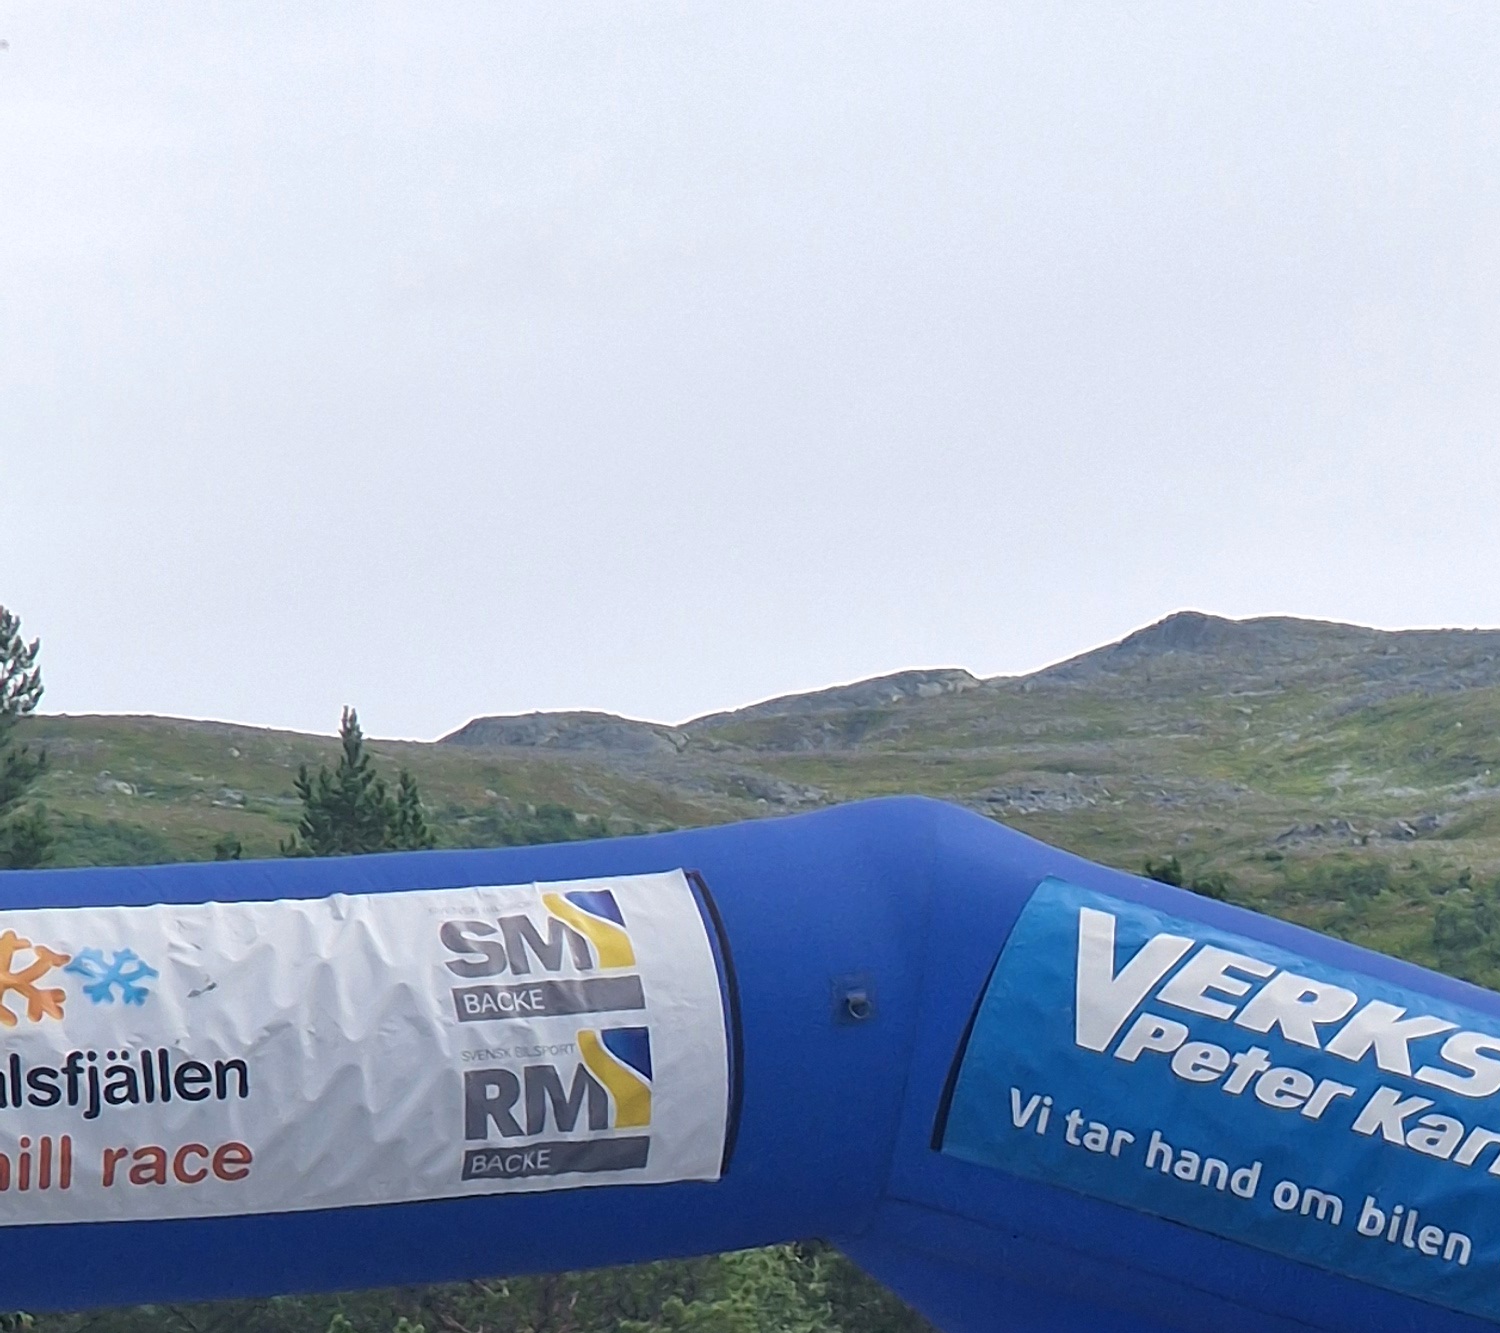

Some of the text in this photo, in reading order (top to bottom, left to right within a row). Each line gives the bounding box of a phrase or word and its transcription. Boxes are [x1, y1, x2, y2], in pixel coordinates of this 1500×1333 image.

[440, 914, 593, 978] SM
[463, 989, 545, 1014] BACKE
[1112, 1011, 1354, 1121] Peter
[464, 1062, 609, 1140] RM
[102, 1141, 253, 1187] race
[471, 1150, 550, 1173] BACKE
[1009, 1087, 1474, 1267] Vi tar hand om bilen
